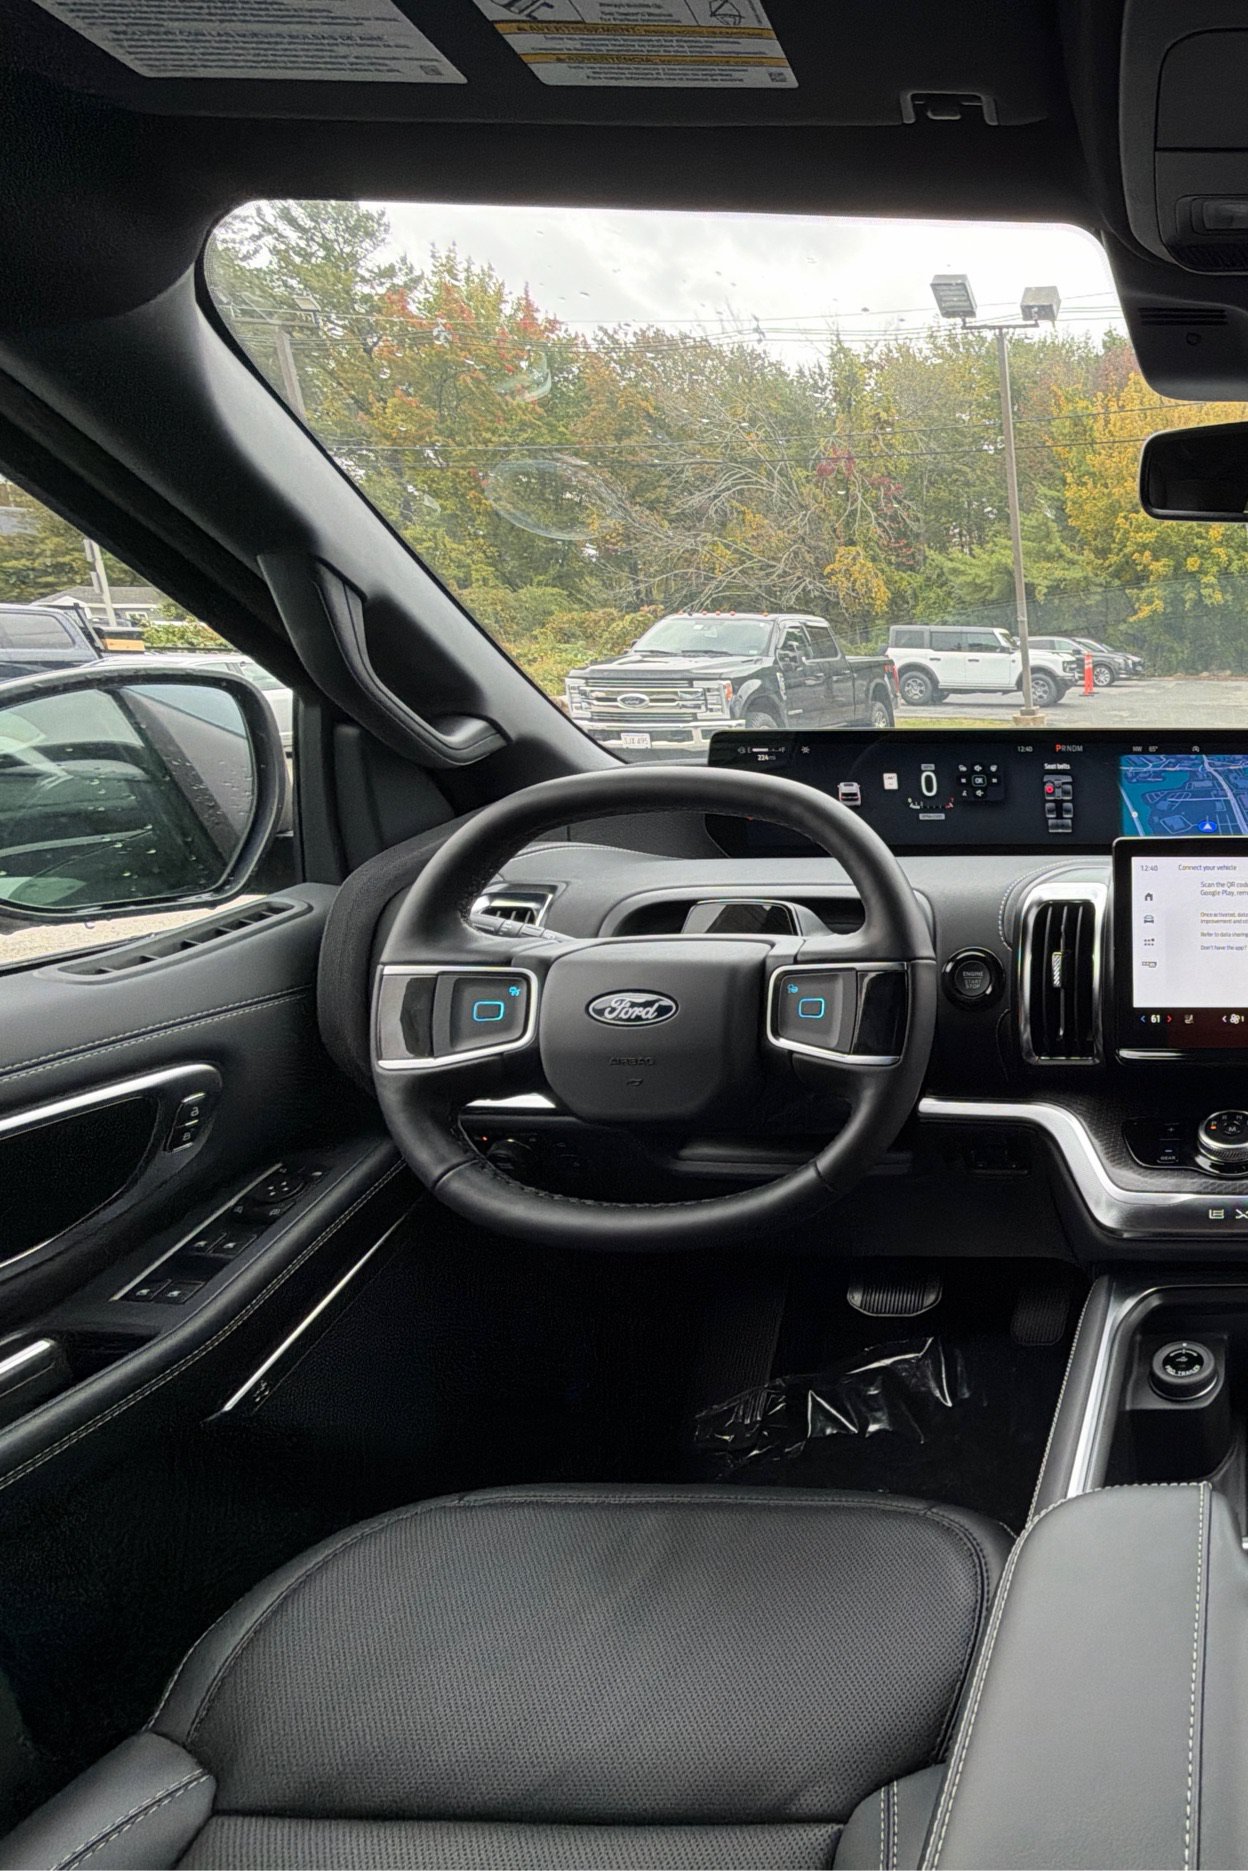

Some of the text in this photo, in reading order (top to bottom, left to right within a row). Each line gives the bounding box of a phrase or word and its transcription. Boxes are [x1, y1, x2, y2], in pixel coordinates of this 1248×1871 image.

[1017, 745, 1034, 753] 12:40
[921, 771, 938, 797] 0
[1140, 864, 1159, 872] 12:40
[1178, 864, 1237, 873] Connect your vehicle
[1200, 881, 1215, 889] Scan
[1216, 881, 1226, 889] the
[1226, 881, 1236, 889] QR
[1200, 889, 1220, 897] Google
[603, 993, 658, 1021] Ford
[1150, 1014, 1161, 1023] 61
[608, 1056, 656, 1067] AIRBAG
